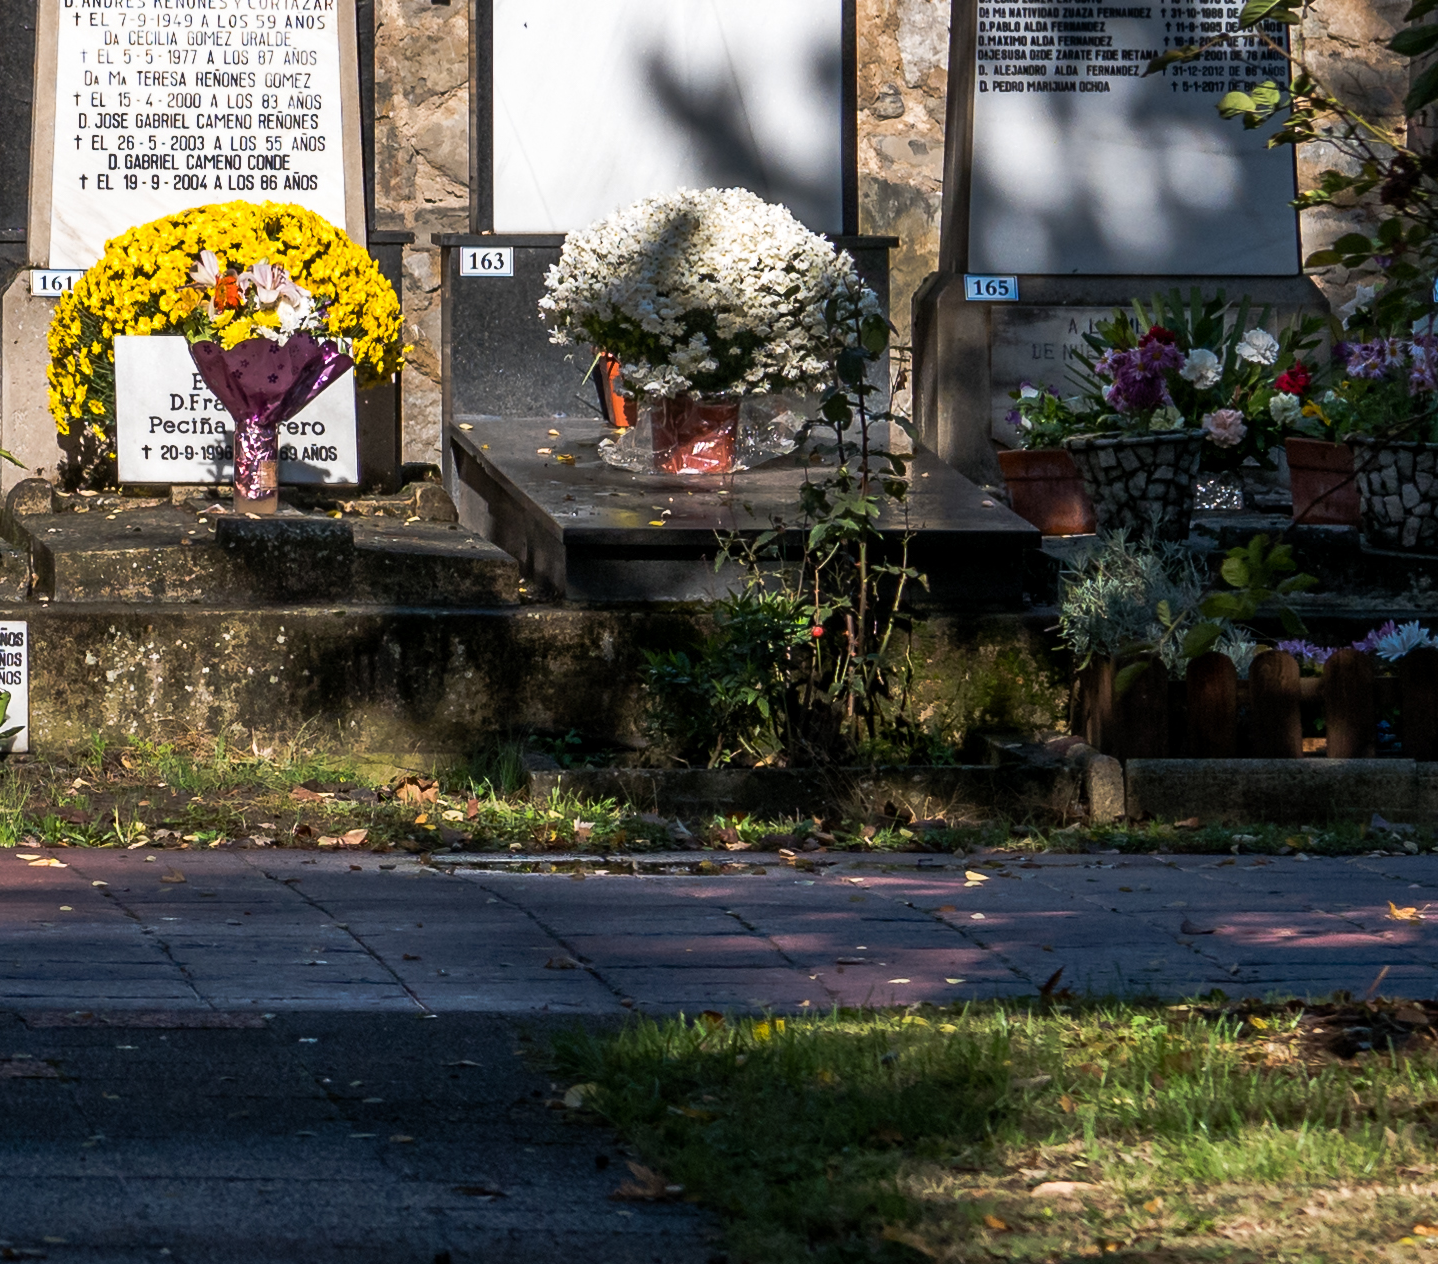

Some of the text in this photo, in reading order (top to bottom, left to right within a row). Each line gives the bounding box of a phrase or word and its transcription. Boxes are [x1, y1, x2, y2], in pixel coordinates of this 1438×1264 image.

[125, 154, 179, 170] GABRIEL
[187, 154, 242, 170] CAMENO
[248, 154, 290, 171] CONDE
[470, 252, 505, 270] 163
[41, 276, 72, 291] 161
[149, 416, 227, 435] Peciña
[280, 443, 298, 461] 69
[302, 444, 338, 462] AÑOS
